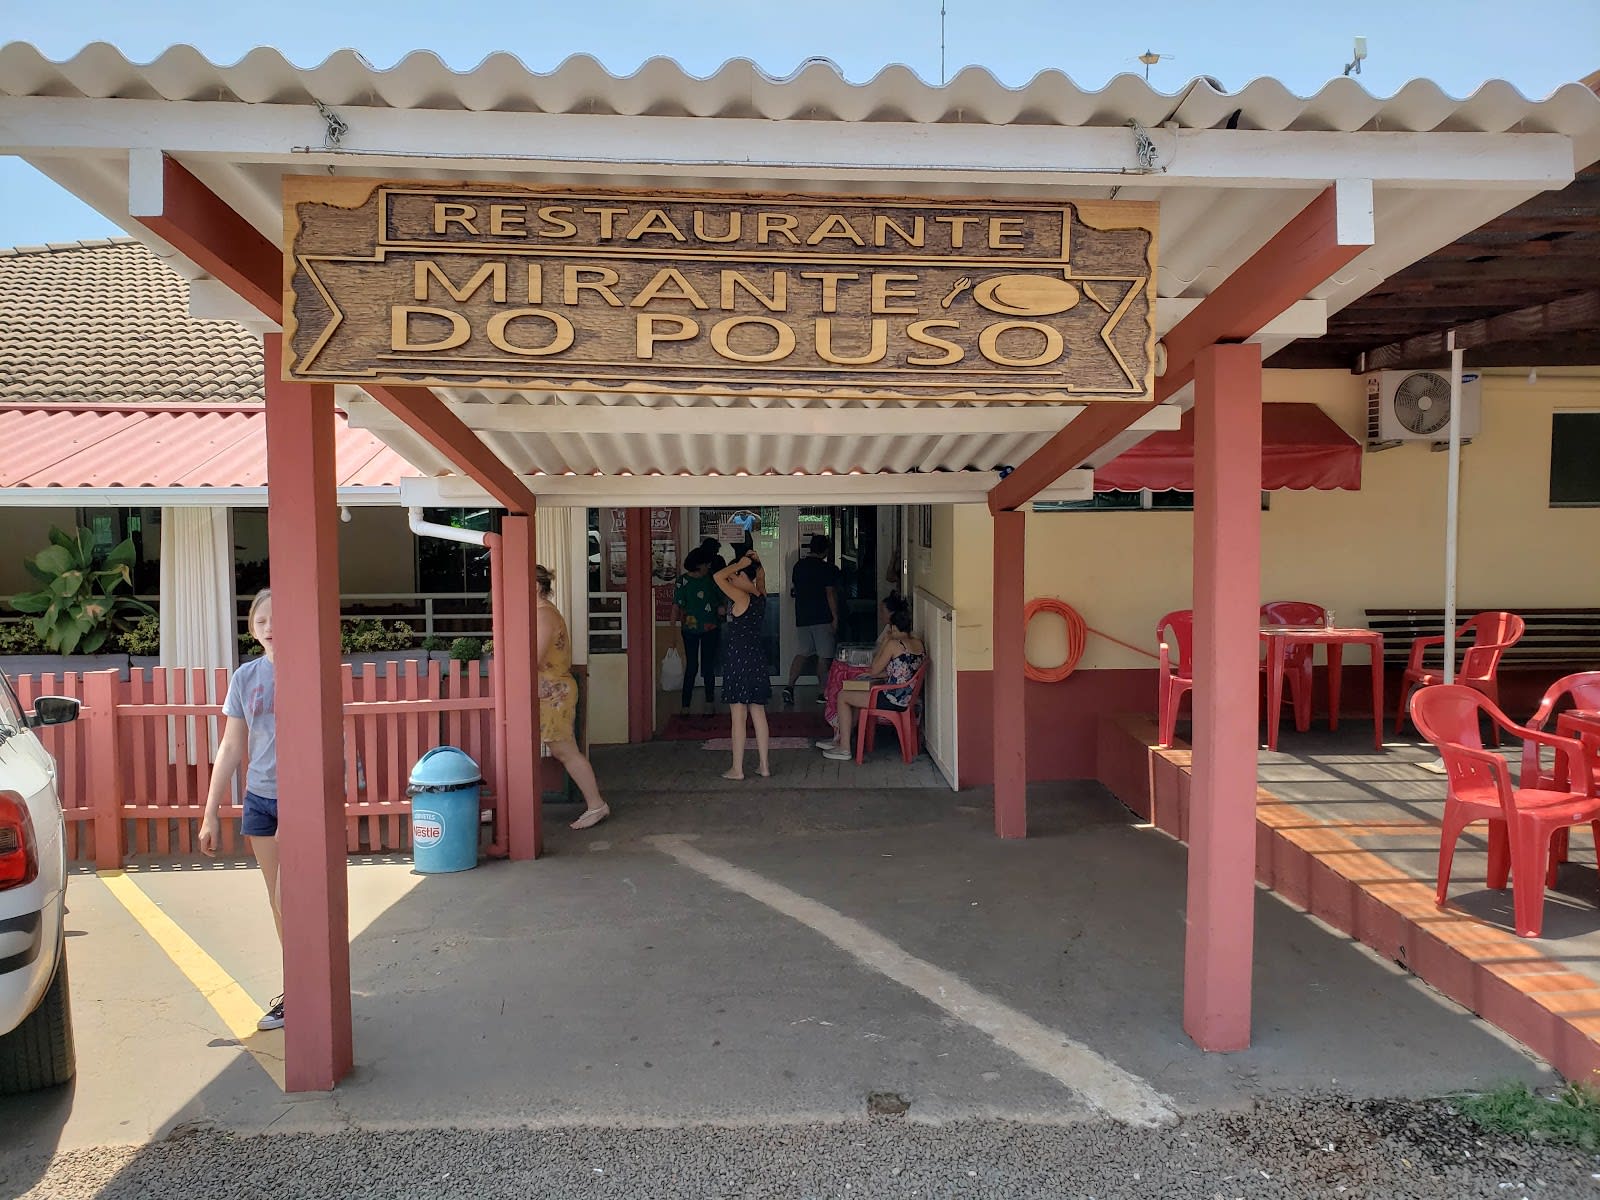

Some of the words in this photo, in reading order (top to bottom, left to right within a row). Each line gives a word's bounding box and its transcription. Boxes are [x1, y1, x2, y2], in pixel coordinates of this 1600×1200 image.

[434, 203, 1025, 250] RESTAURANTE
[414, 260, 919, 314] MIRANTE
[391, 305, 575, 356] DO
[636, 313, 1064, 368] POUSO
